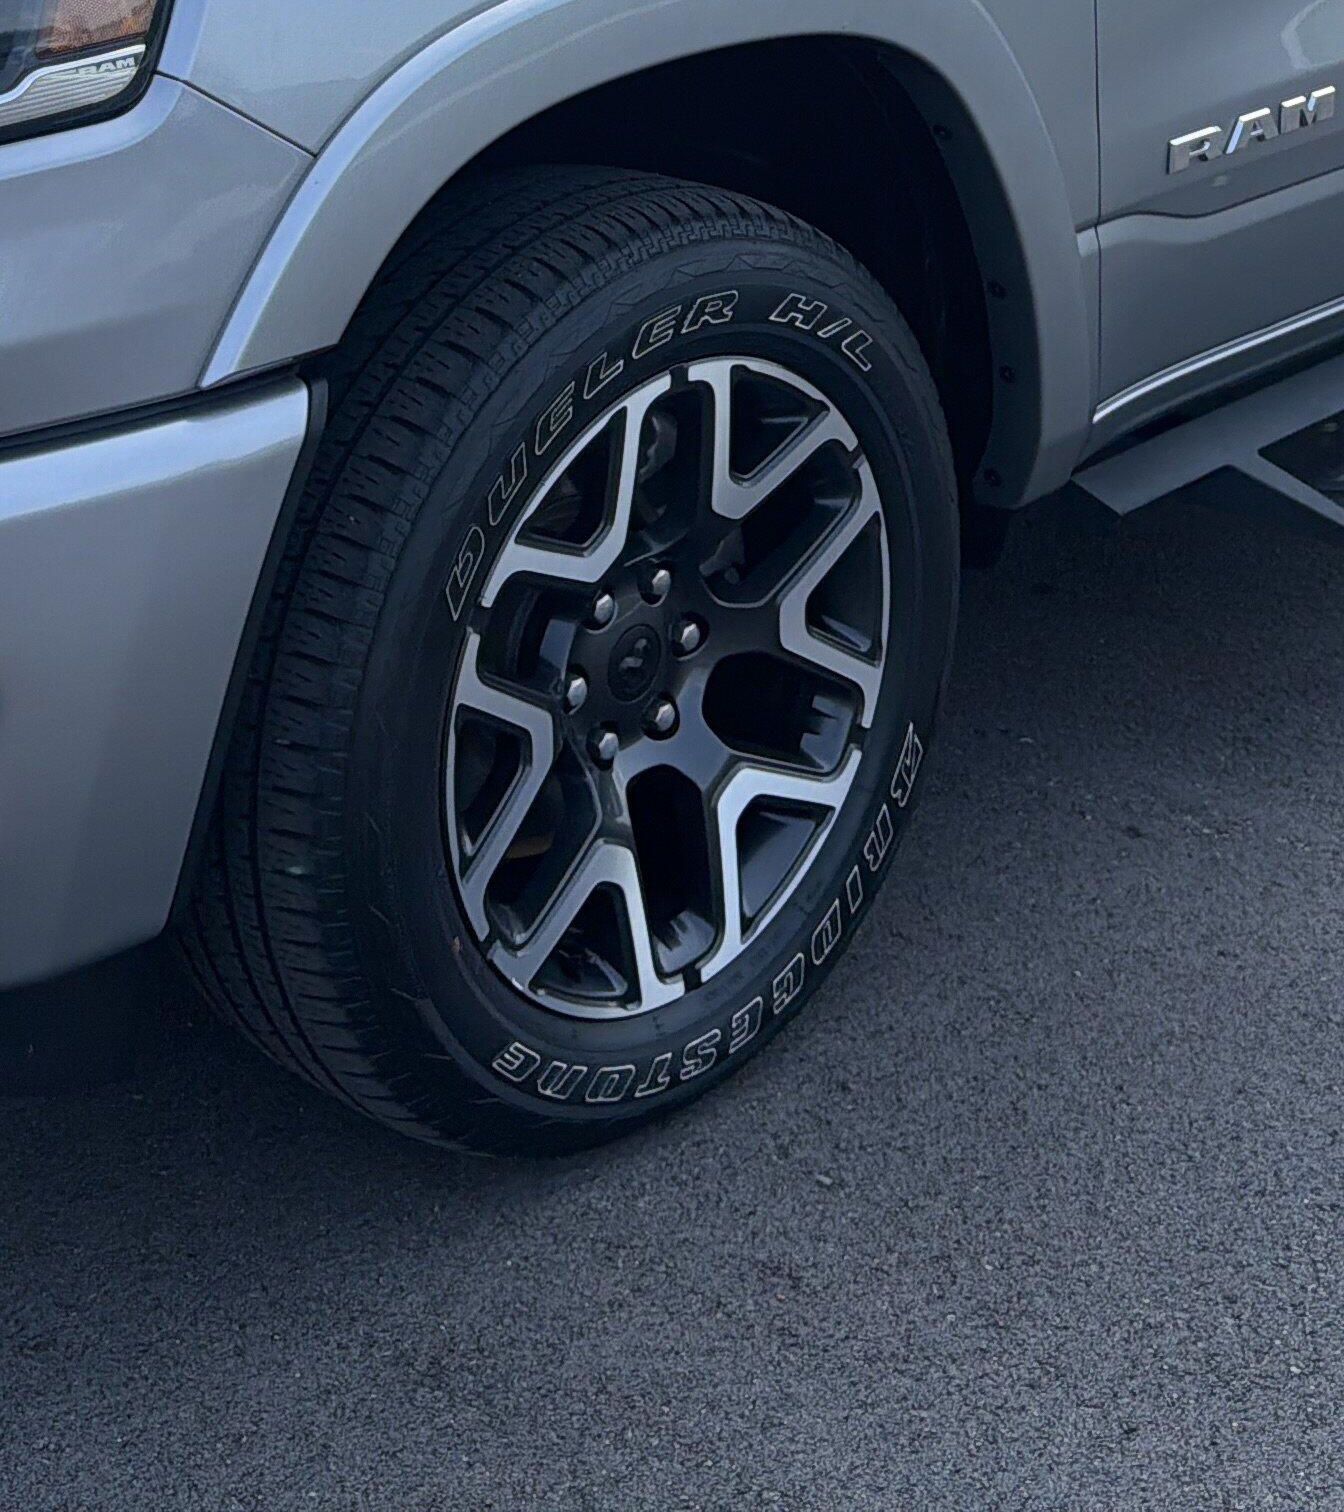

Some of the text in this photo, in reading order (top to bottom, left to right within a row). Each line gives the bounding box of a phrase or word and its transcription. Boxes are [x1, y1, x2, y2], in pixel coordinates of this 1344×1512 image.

[1166, 85, 1337, 176] RAM
[445, 289, 873, 622] DUELER H/L
[491, 721, 924, 1104] BRIDGESTONE
